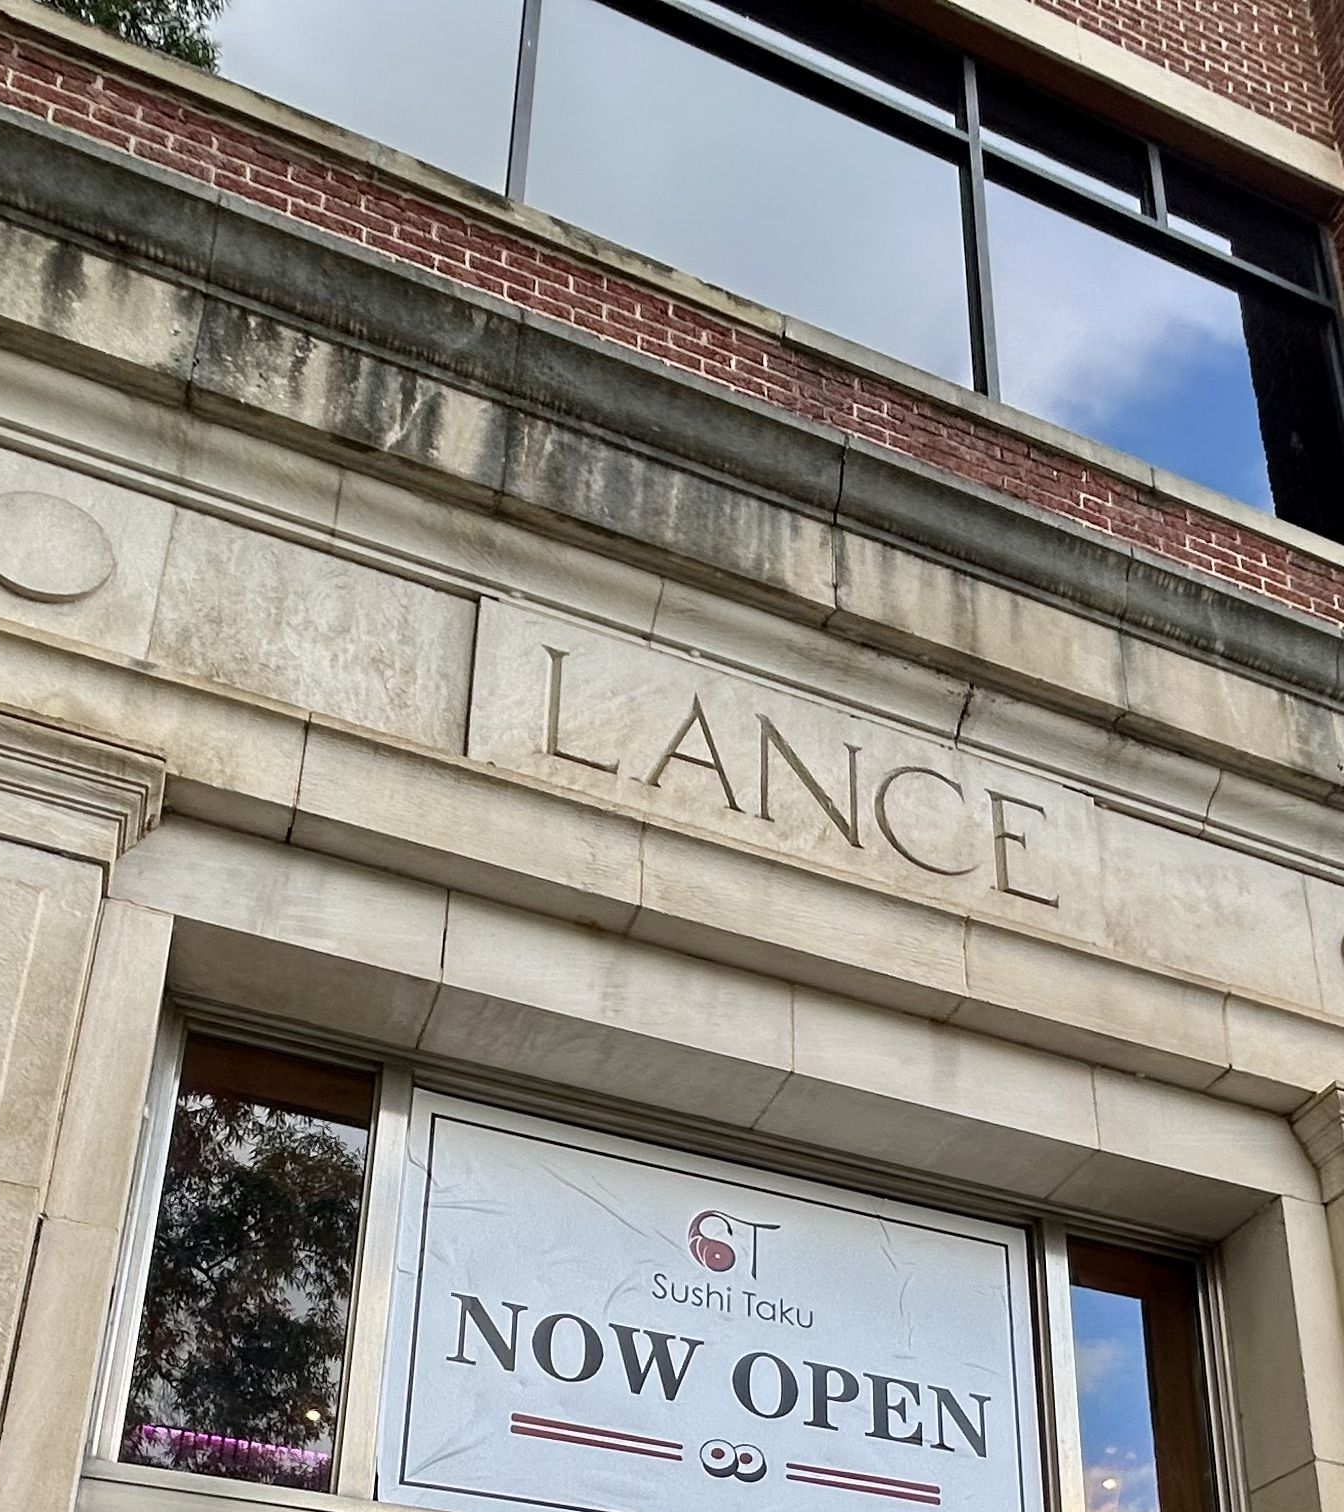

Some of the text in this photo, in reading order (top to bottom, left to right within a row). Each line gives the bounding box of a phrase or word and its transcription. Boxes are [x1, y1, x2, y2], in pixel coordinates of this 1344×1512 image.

[541, 643, 1060, 909] LANCE
[445, 1291, 992, 1459] NOW OPEN
[652, 1273, 814, 1329] Sushi Taku
